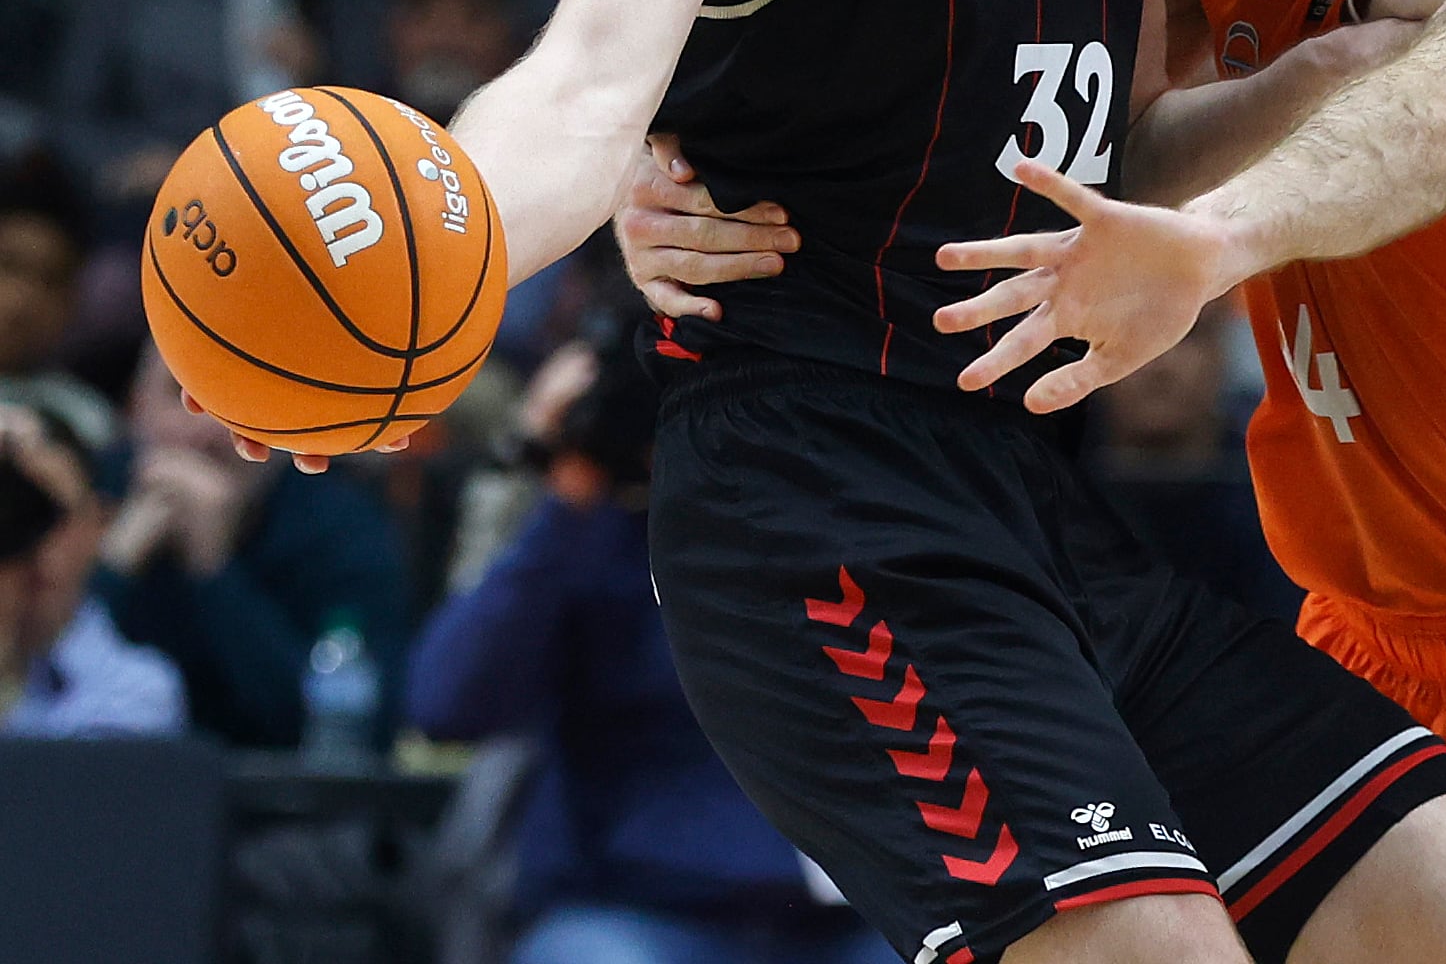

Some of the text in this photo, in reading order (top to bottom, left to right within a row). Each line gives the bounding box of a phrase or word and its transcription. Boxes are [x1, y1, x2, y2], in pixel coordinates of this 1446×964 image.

[995, 41, 1113, 185] 32
[256, 90, 384, 269] Wilson
[442, 168, 469, 234] liga
[182, 199, 238, 278] acb
[1278, 303, 1362, 444] 4
[1076, 826, 1134, 850] hummel
